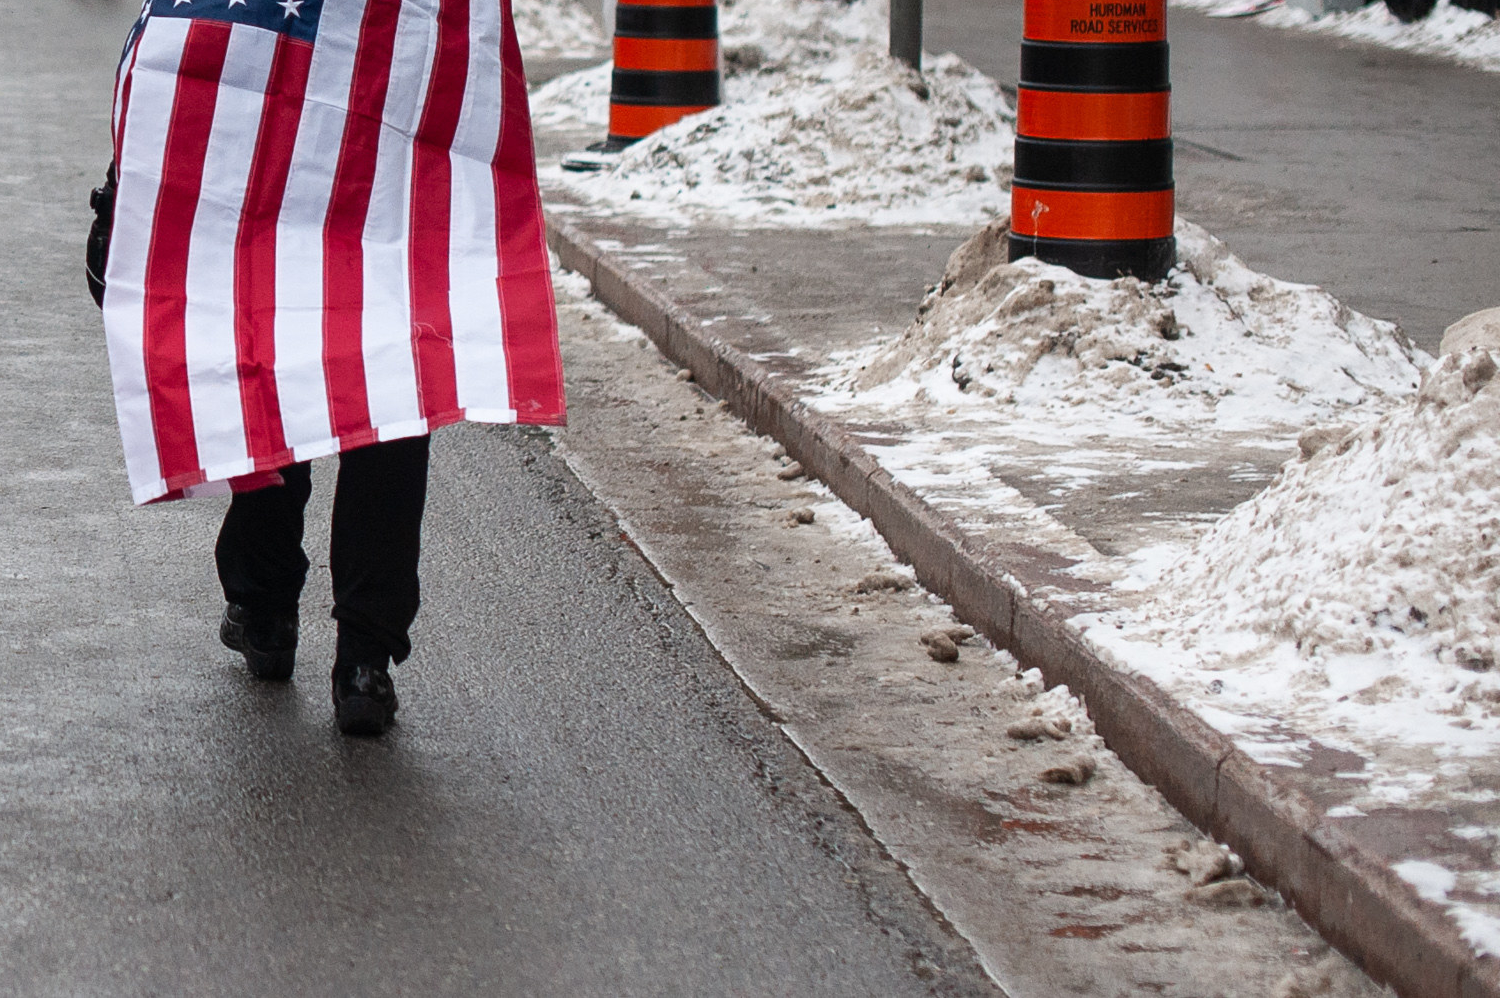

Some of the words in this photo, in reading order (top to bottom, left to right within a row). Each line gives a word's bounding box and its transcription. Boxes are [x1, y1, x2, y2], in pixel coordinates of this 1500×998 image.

[1090, 3, 1147, 17] HURDMAN
[1070, 20, 1104, 34] ROAD
[1108, 19, 1158, 34] SERVICES
